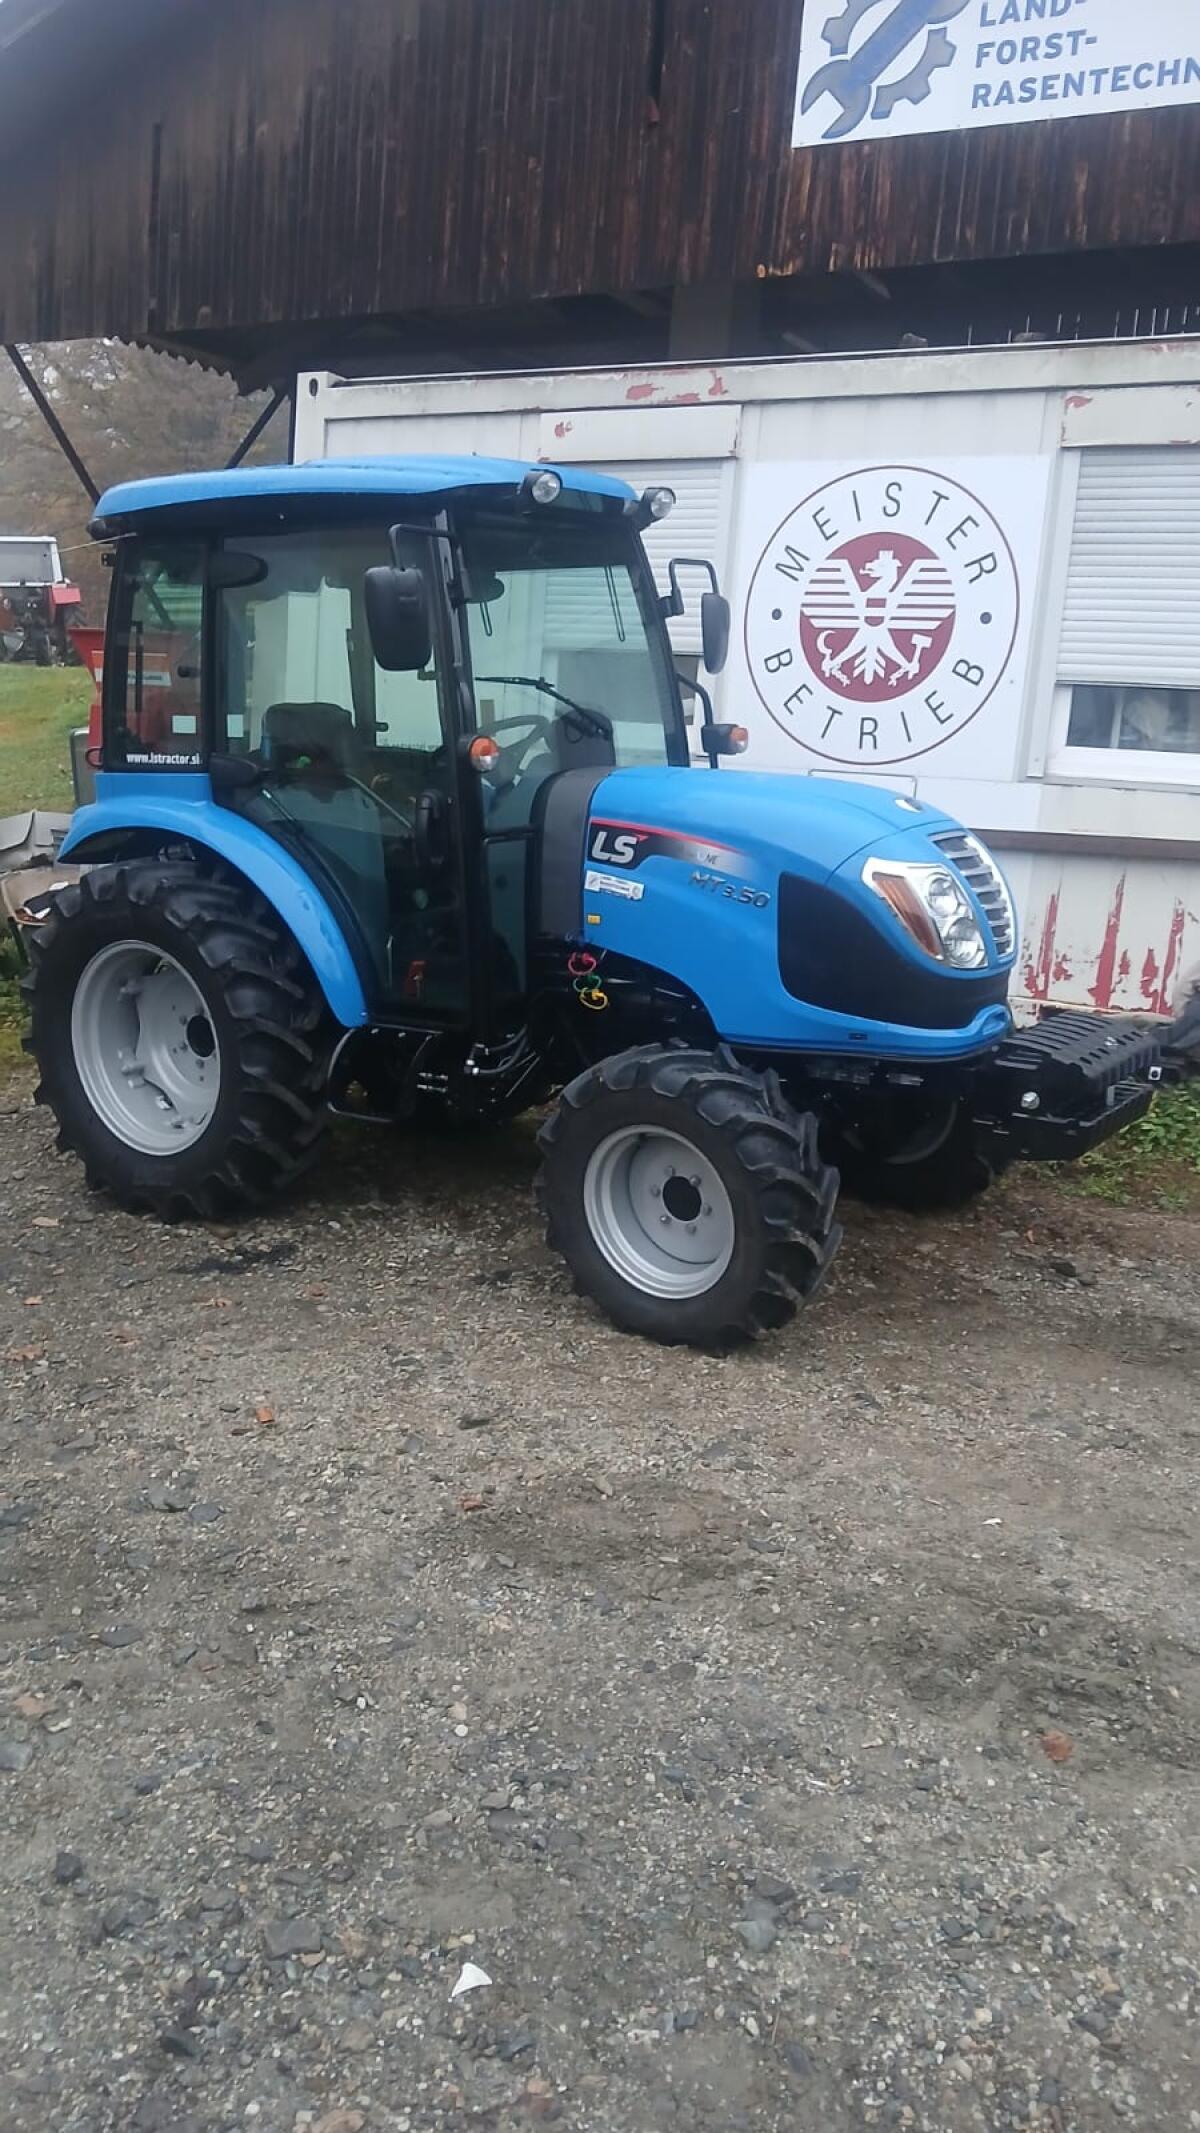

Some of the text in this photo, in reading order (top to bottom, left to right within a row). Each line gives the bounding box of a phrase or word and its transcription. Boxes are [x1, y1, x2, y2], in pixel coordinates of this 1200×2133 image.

[980, 0, 1087, 27] LAND-
[976, 29, 1097, 68] FORST-
[775, 482, 997, 583] MEISTER
[764, 648, 985, 750] BETRIEB
[126, 752, 200, 764] www.lstractor.si
[591, 831, 638, 864] LS
